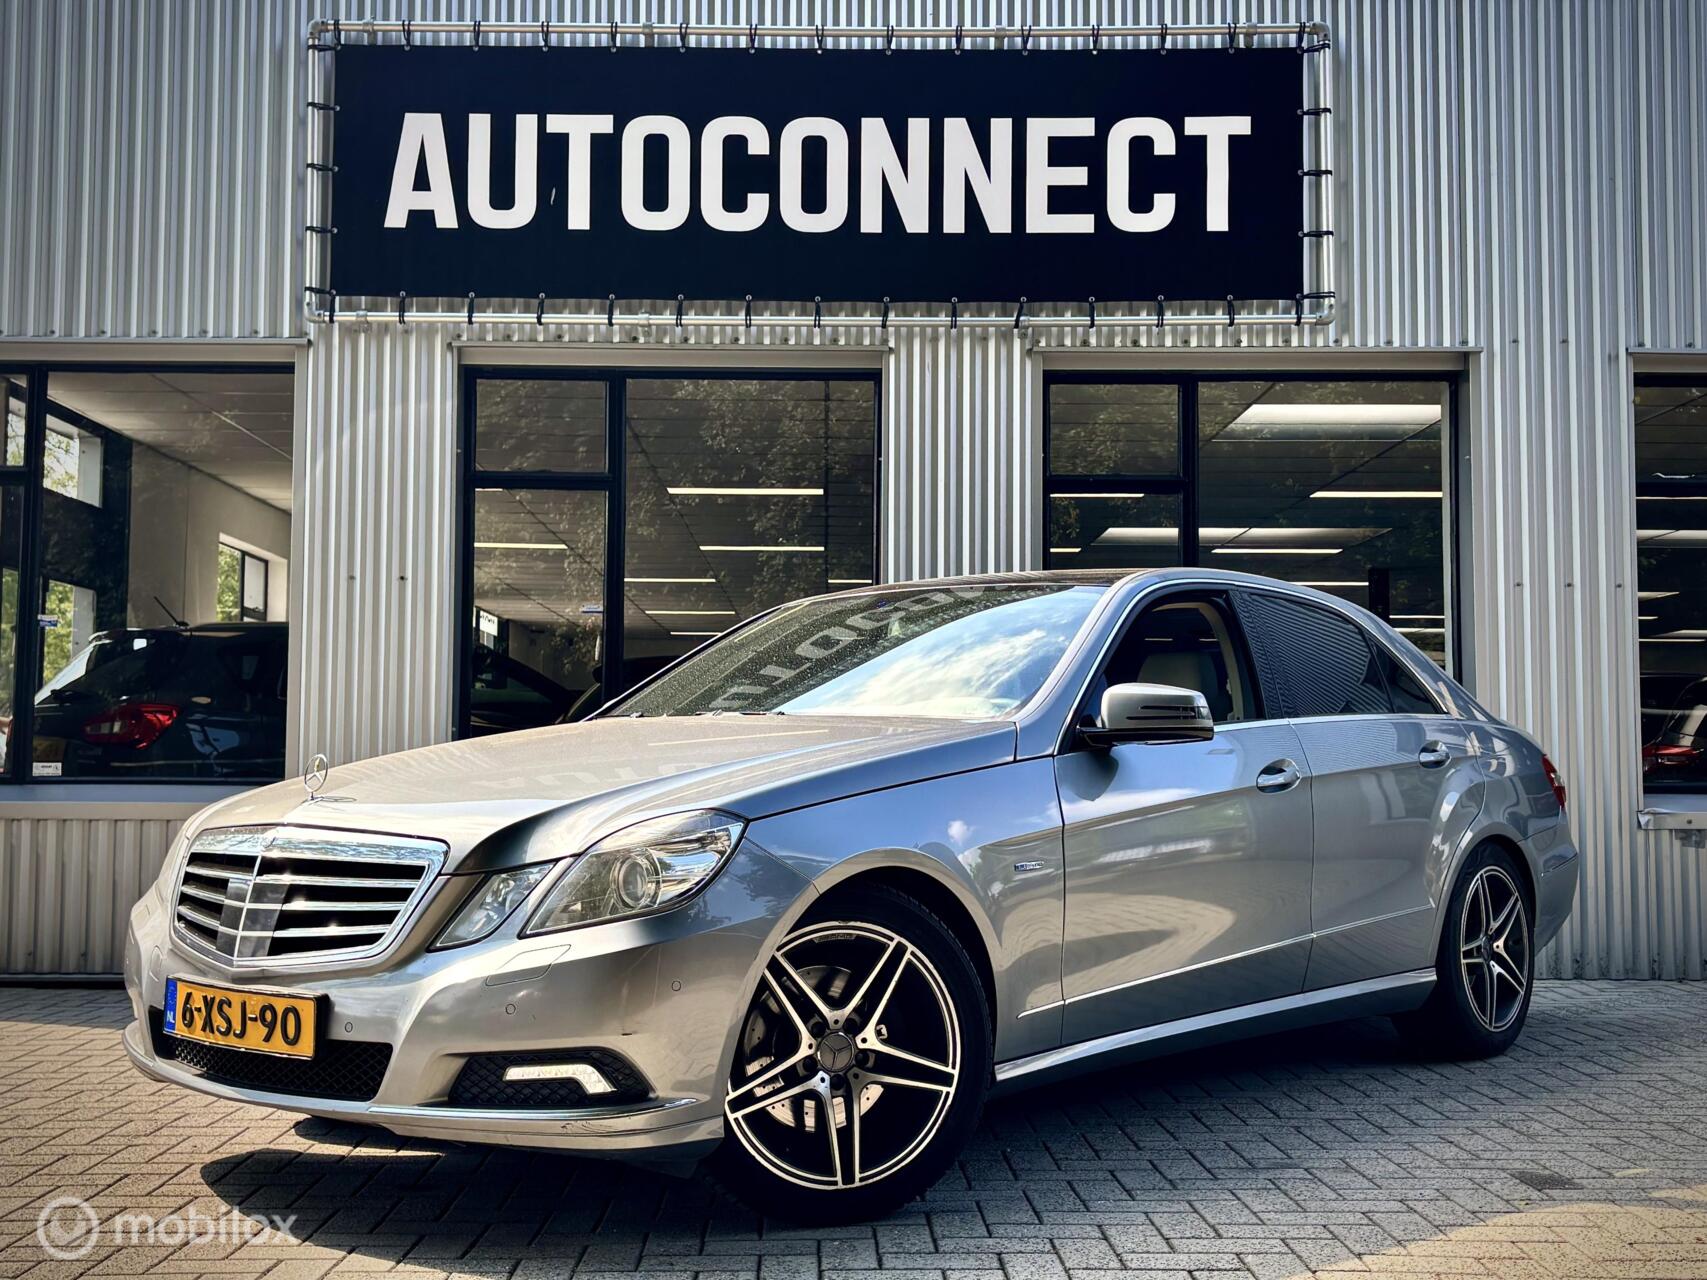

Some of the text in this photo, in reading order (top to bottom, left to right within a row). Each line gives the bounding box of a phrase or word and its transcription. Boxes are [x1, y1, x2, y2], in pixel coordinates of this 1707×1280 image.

[384, 113, 1251, 233] AUTOCONNECT
[166, 1010, 175, 1023] NL
[181, 991, 303, 1046] 6-XSJ-90
